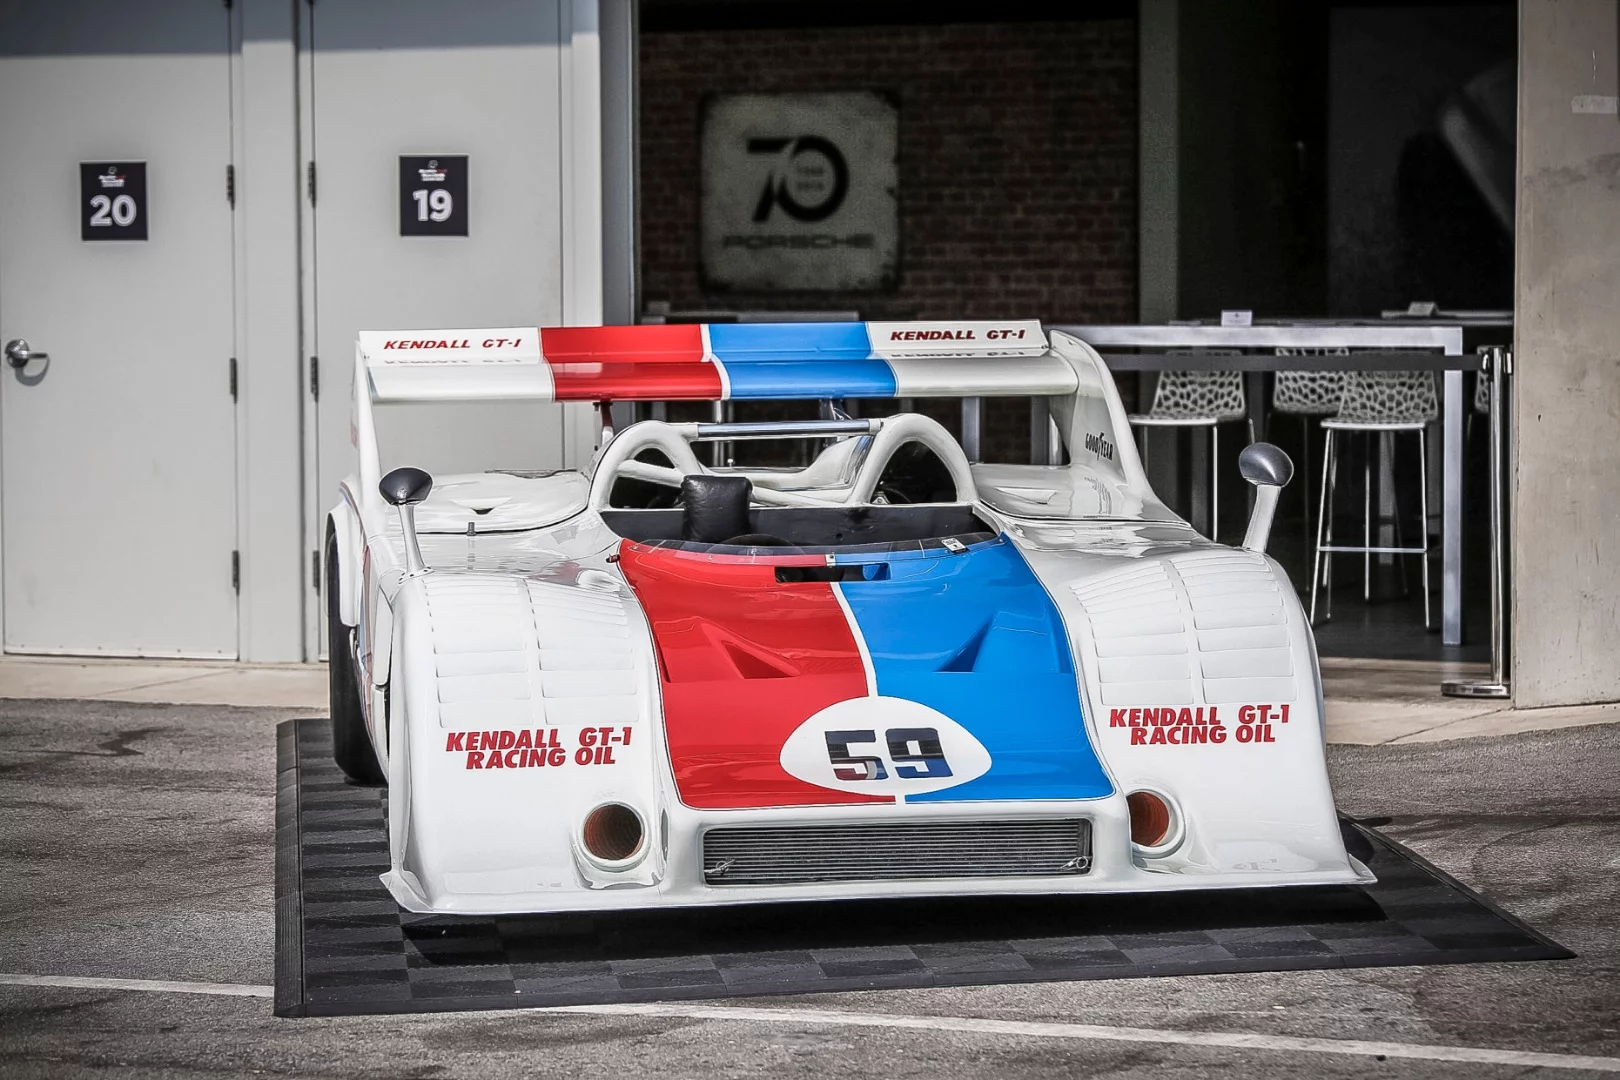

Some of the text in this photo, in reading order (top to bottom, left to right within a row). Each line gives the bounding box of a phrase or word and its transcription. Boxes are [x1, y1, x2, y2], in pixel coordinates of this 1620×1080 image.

[747, 135, 849, 223] 70
[90, 194, 137, 227] 20
[412, 188, 454, 223] 19
[383, 339, 471, 350] KENDALL
[890, 330, 976, 341] KENDALL
[1084, 432, 1114, 461] GOODYEAR
[1109, 704, 1290, 728] KENDALL GT-1
[445, 726, 632, 752] KENDALL GT-1
[1130, 724, 1276, 746] RACING OIL
[466, 746, 616, 770] RACING OIL
[824, 727, 954, 781] 59
